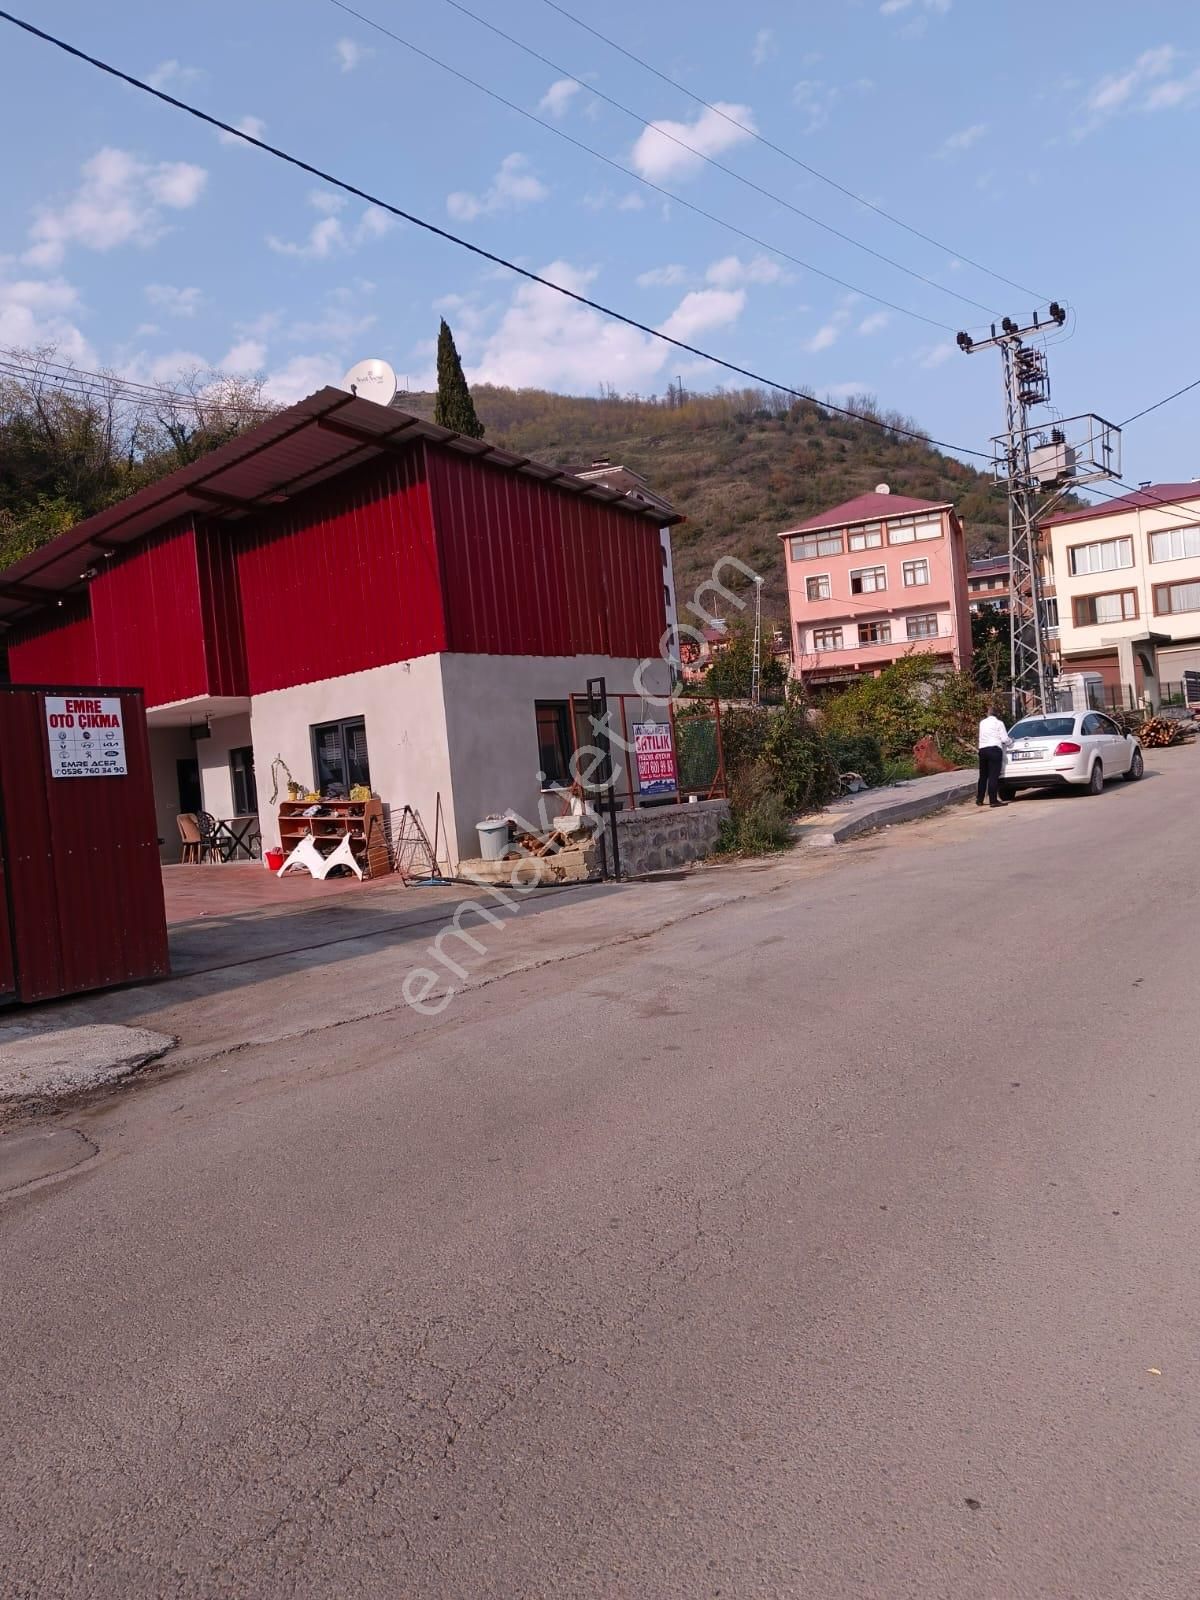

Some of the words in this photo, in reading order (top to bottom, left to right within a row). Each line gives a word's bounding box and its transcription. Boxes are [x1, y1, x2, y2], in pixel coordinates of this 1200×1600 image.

[65, 699, 103, 714] EMRE
[49, 714, 74, 729] OTO
[78, 714, 120, 730] ÇIKMA
[636, 735, 670, 751] SATILIK
[61, 760, 89, 768] EMRE
